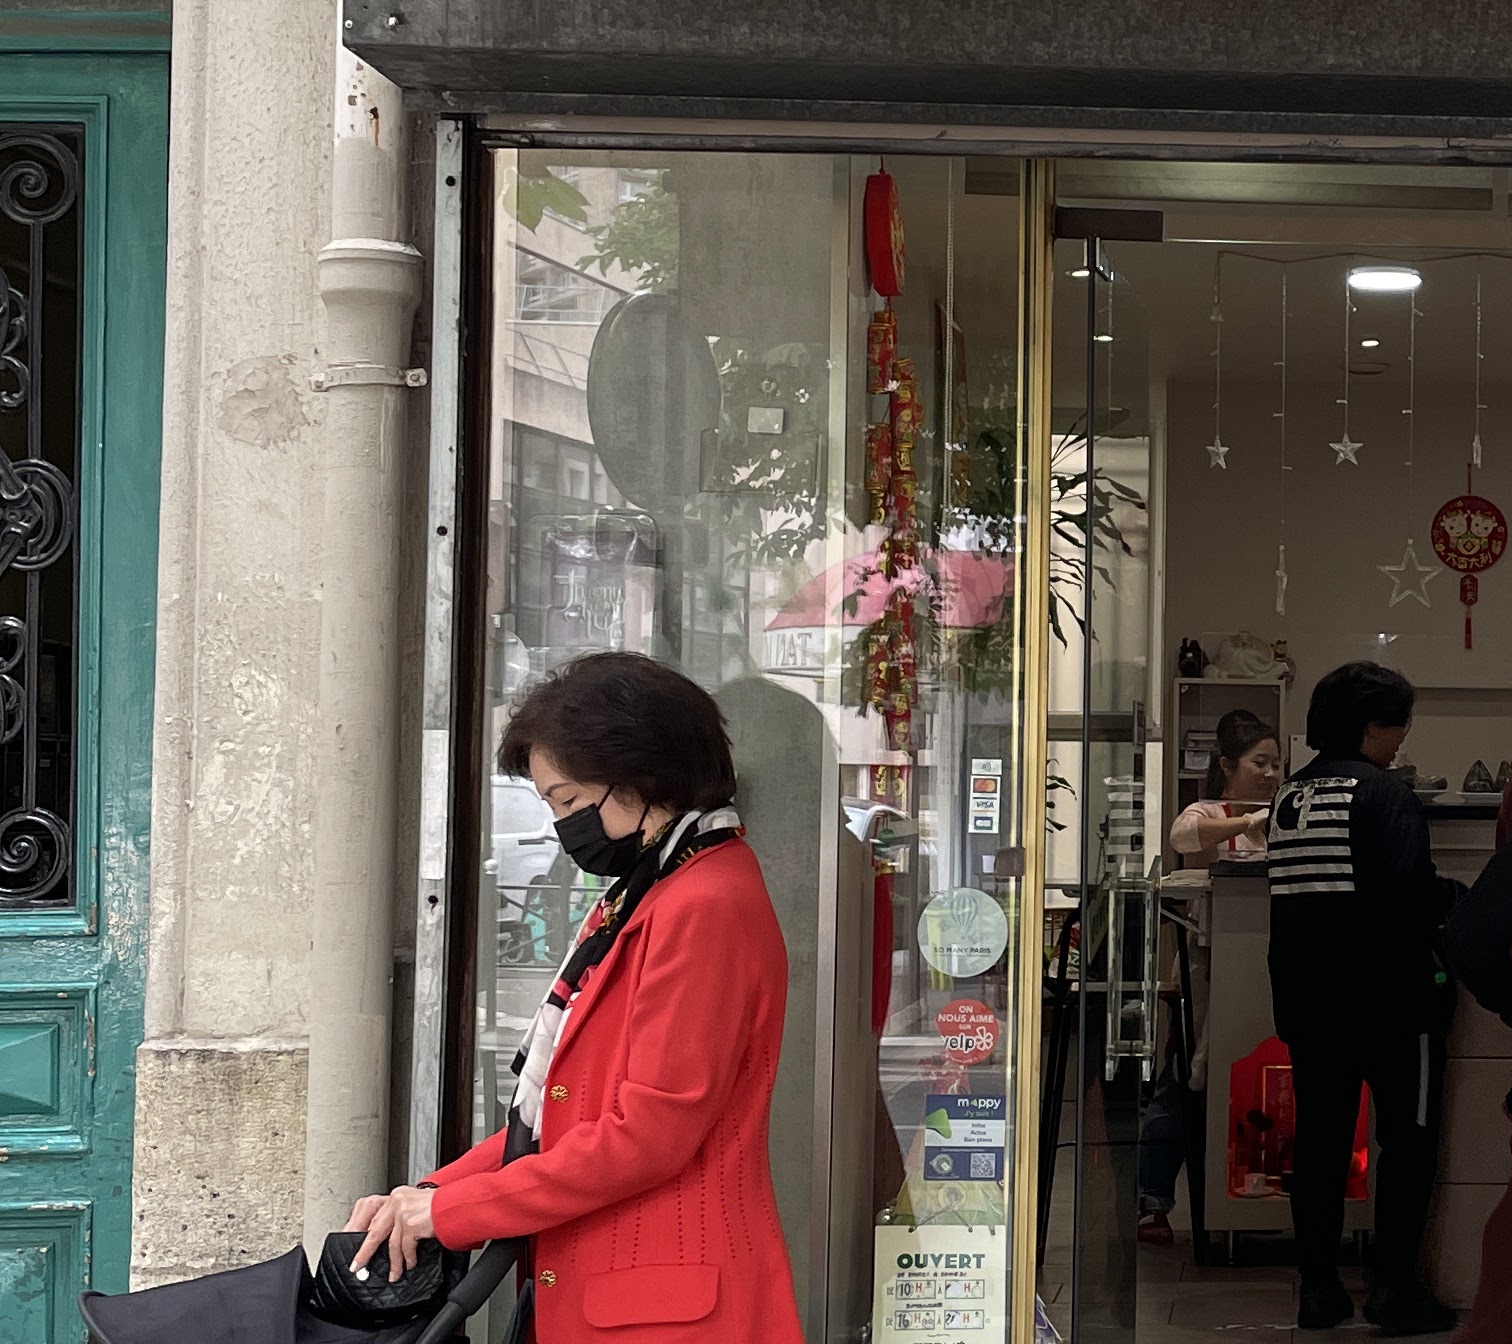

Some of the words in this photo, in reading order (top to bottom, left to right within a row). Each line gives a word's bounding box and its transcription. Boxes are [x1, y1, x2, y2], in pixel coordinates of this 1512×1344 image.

[946, 946, 967, 954] MANY
[969, 946, 992, 954] PARIS
[958, 1005, 973, 1013] ON
[937, 1013, 967, 1022] NOUS
[968, 1014, 995, 1023] AIME
[896, 1253, 986, 1269] OUVERT
[900, 1283, 911, 1296] 10
[898, 1313, 909, 1328] 16
